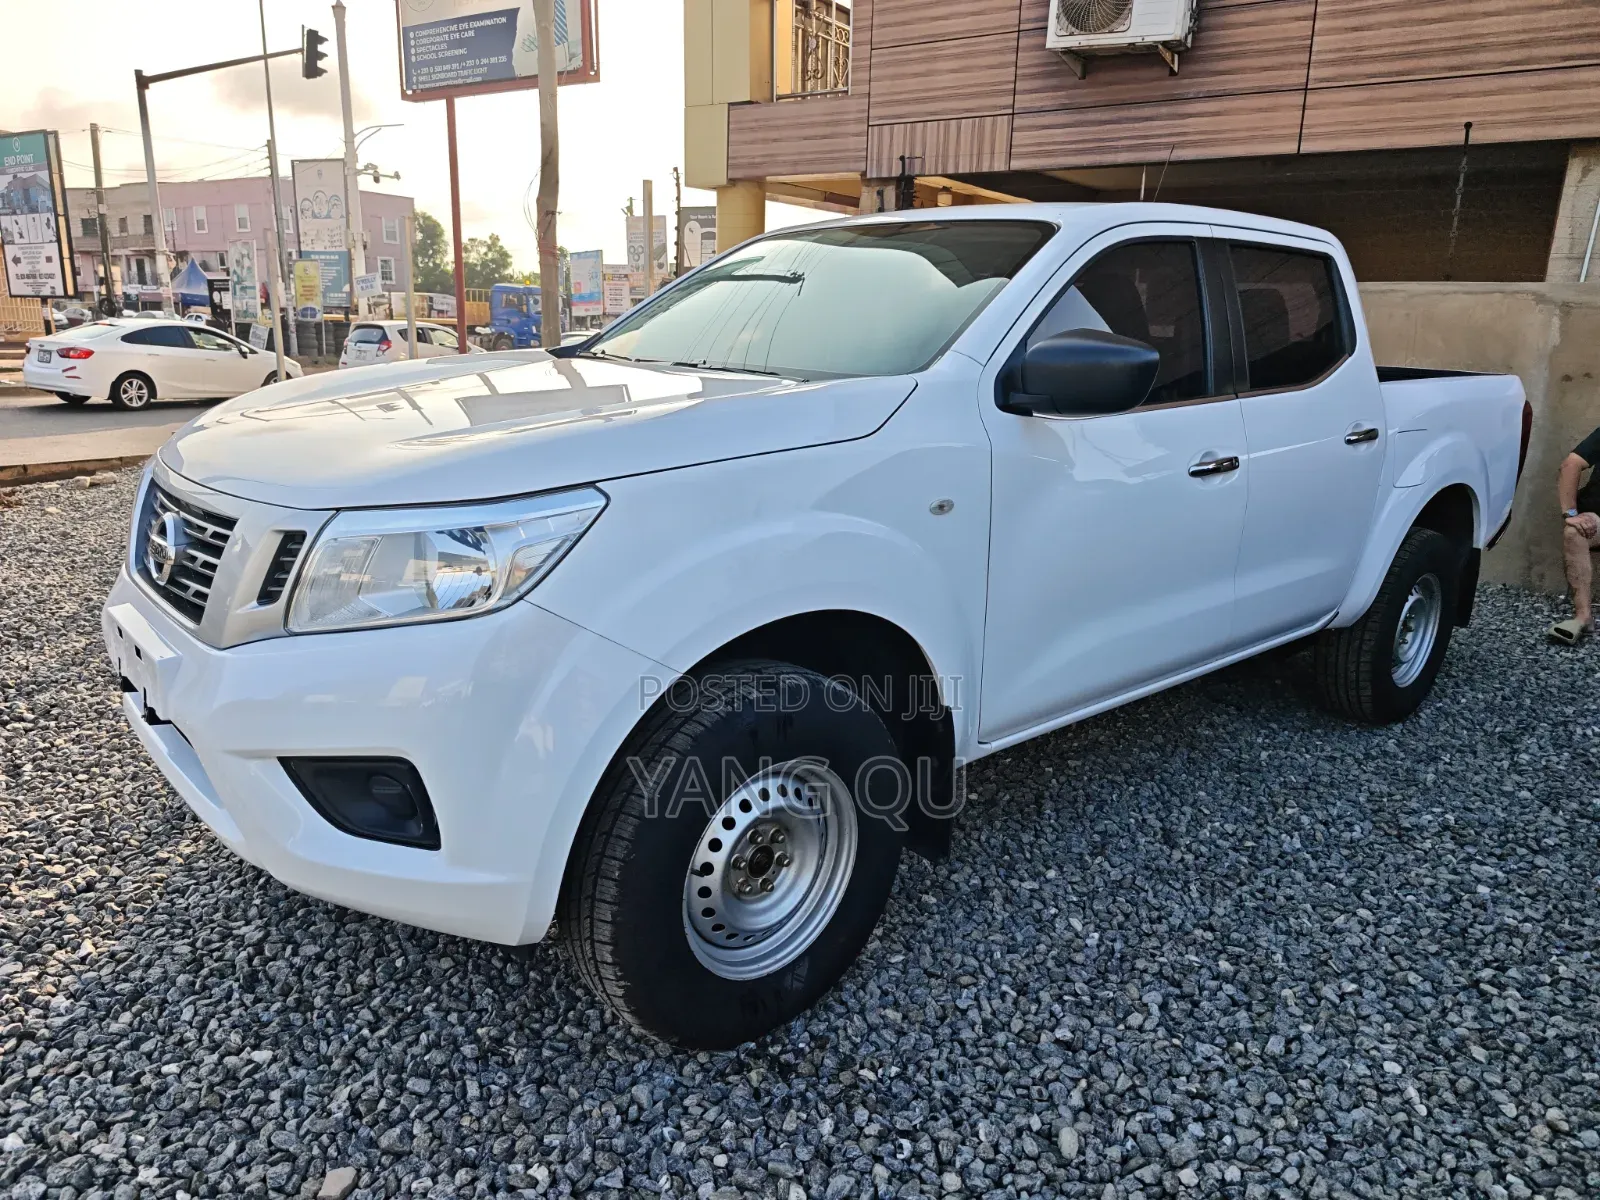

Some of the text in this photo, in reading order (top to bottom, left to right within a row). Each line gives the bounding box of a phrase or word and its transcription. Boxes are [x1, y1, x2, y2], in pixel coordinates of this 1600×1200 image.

[459, 22, 469, 30] EYE
[470, 16, 507, 28] EXAMINATION
[450, 32, 460, 40] EYE
[461, 30, 475, 38] CARE
[416, 43, 448, 53] SPECTACLES
[416, 48, 467, 62] SCHOOL SCREENING
[4, 153, 34, 166] END POINT
